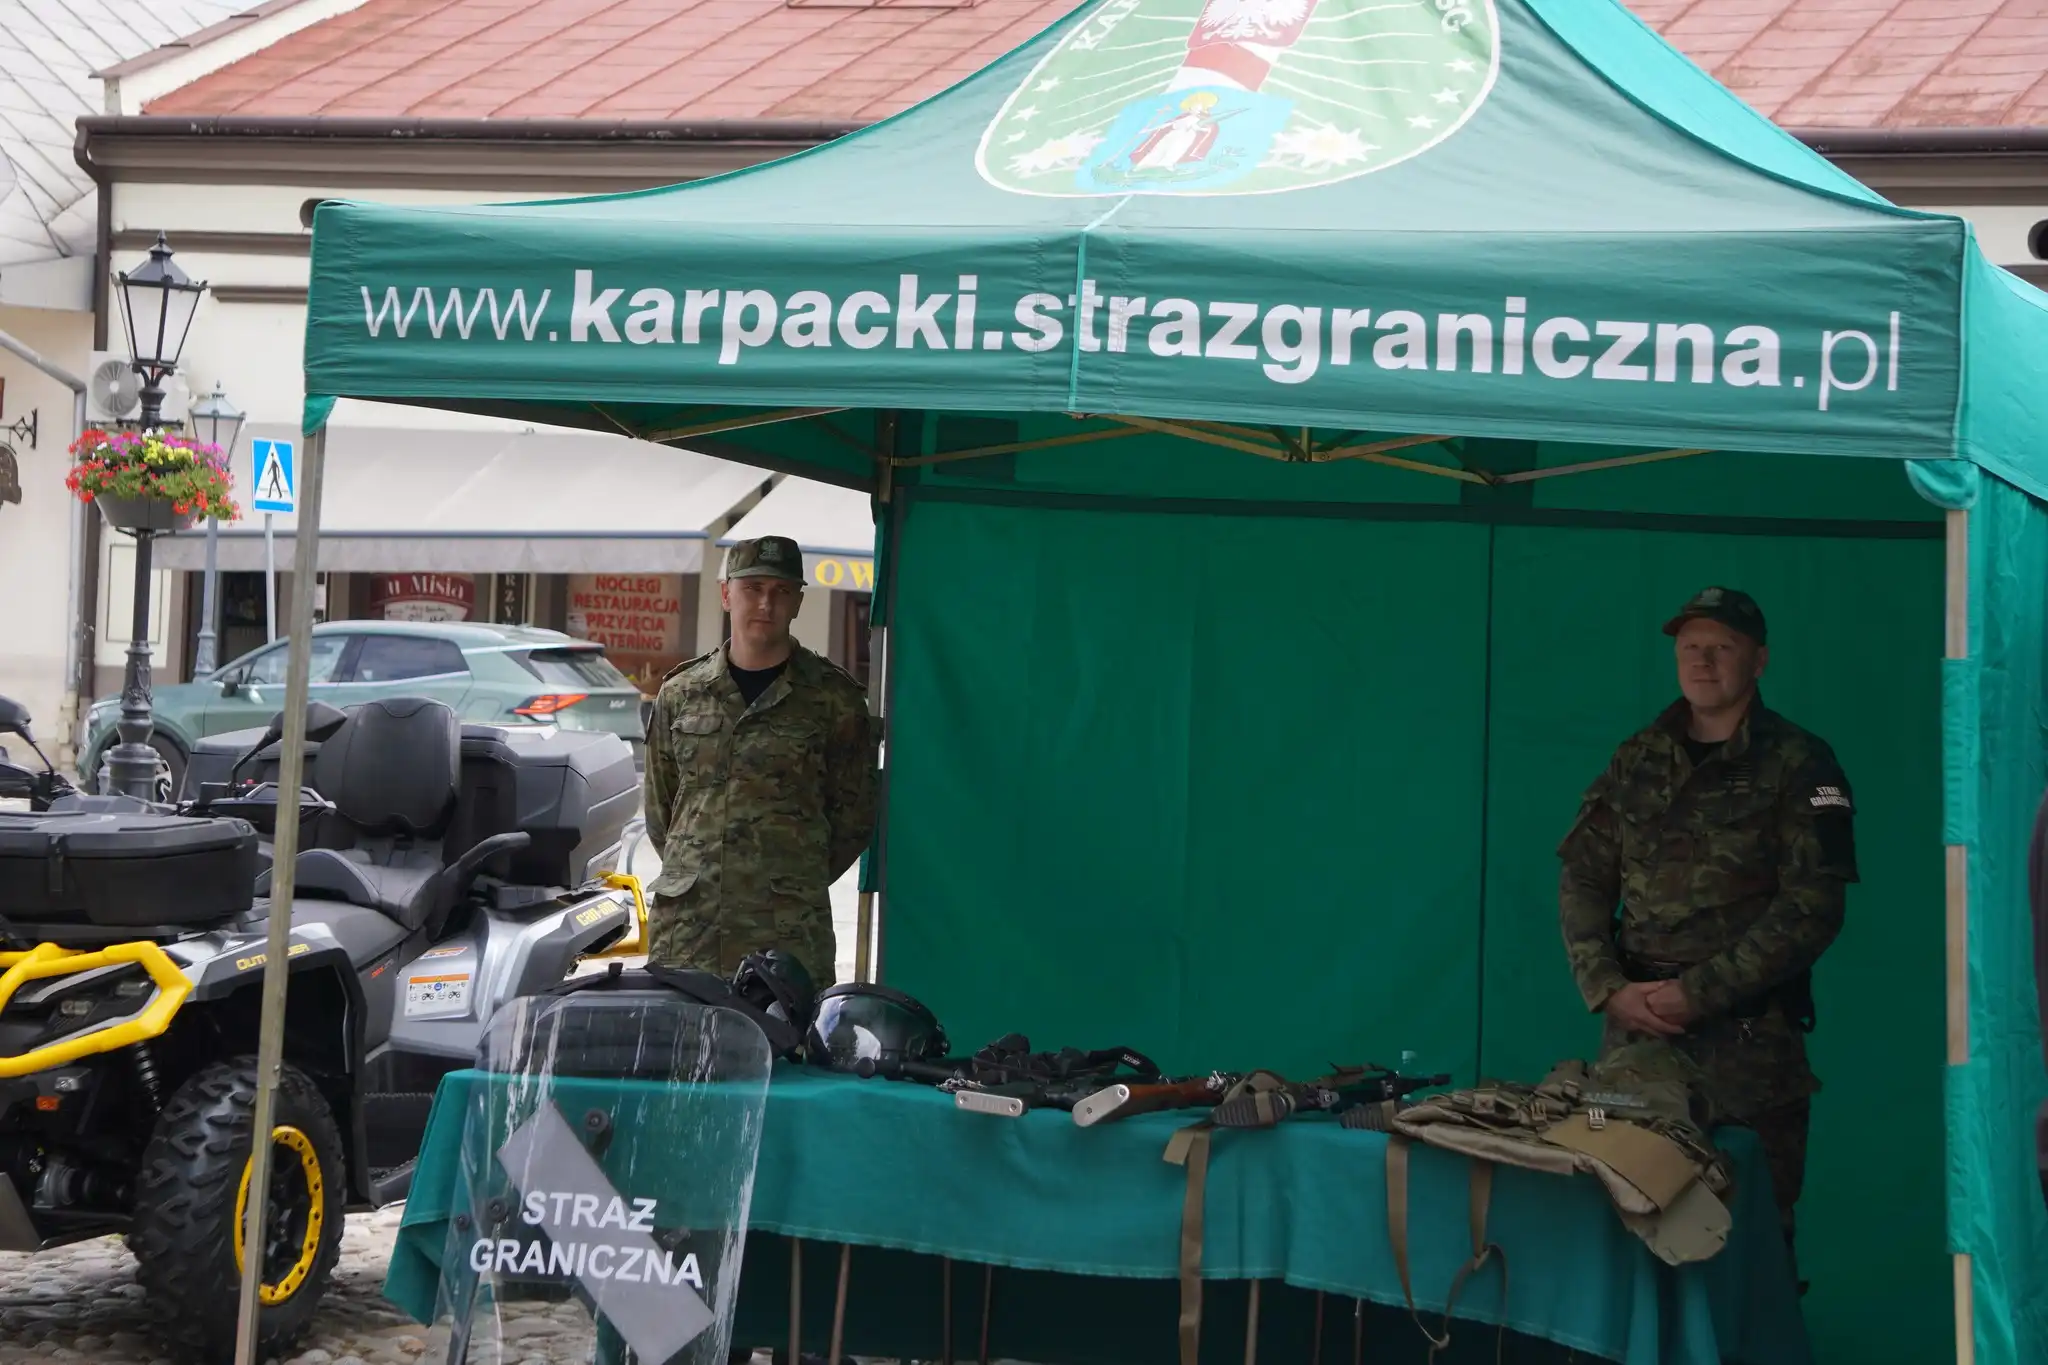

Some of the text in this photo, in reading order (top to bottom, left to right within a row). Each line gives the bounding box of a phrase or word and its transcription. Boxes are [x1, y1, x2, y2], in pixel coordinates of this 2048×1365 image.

[360, 268, 1901, 412] www.karpacki.strazgraniczna.pl
[595, 575, 662, 594] NOCLEGI
[574, 593, 681, 614] RESTAURACJA
[588, 631, 663, 651] CATERING
[470, 1237, 704, 1289] GRANICZNA
